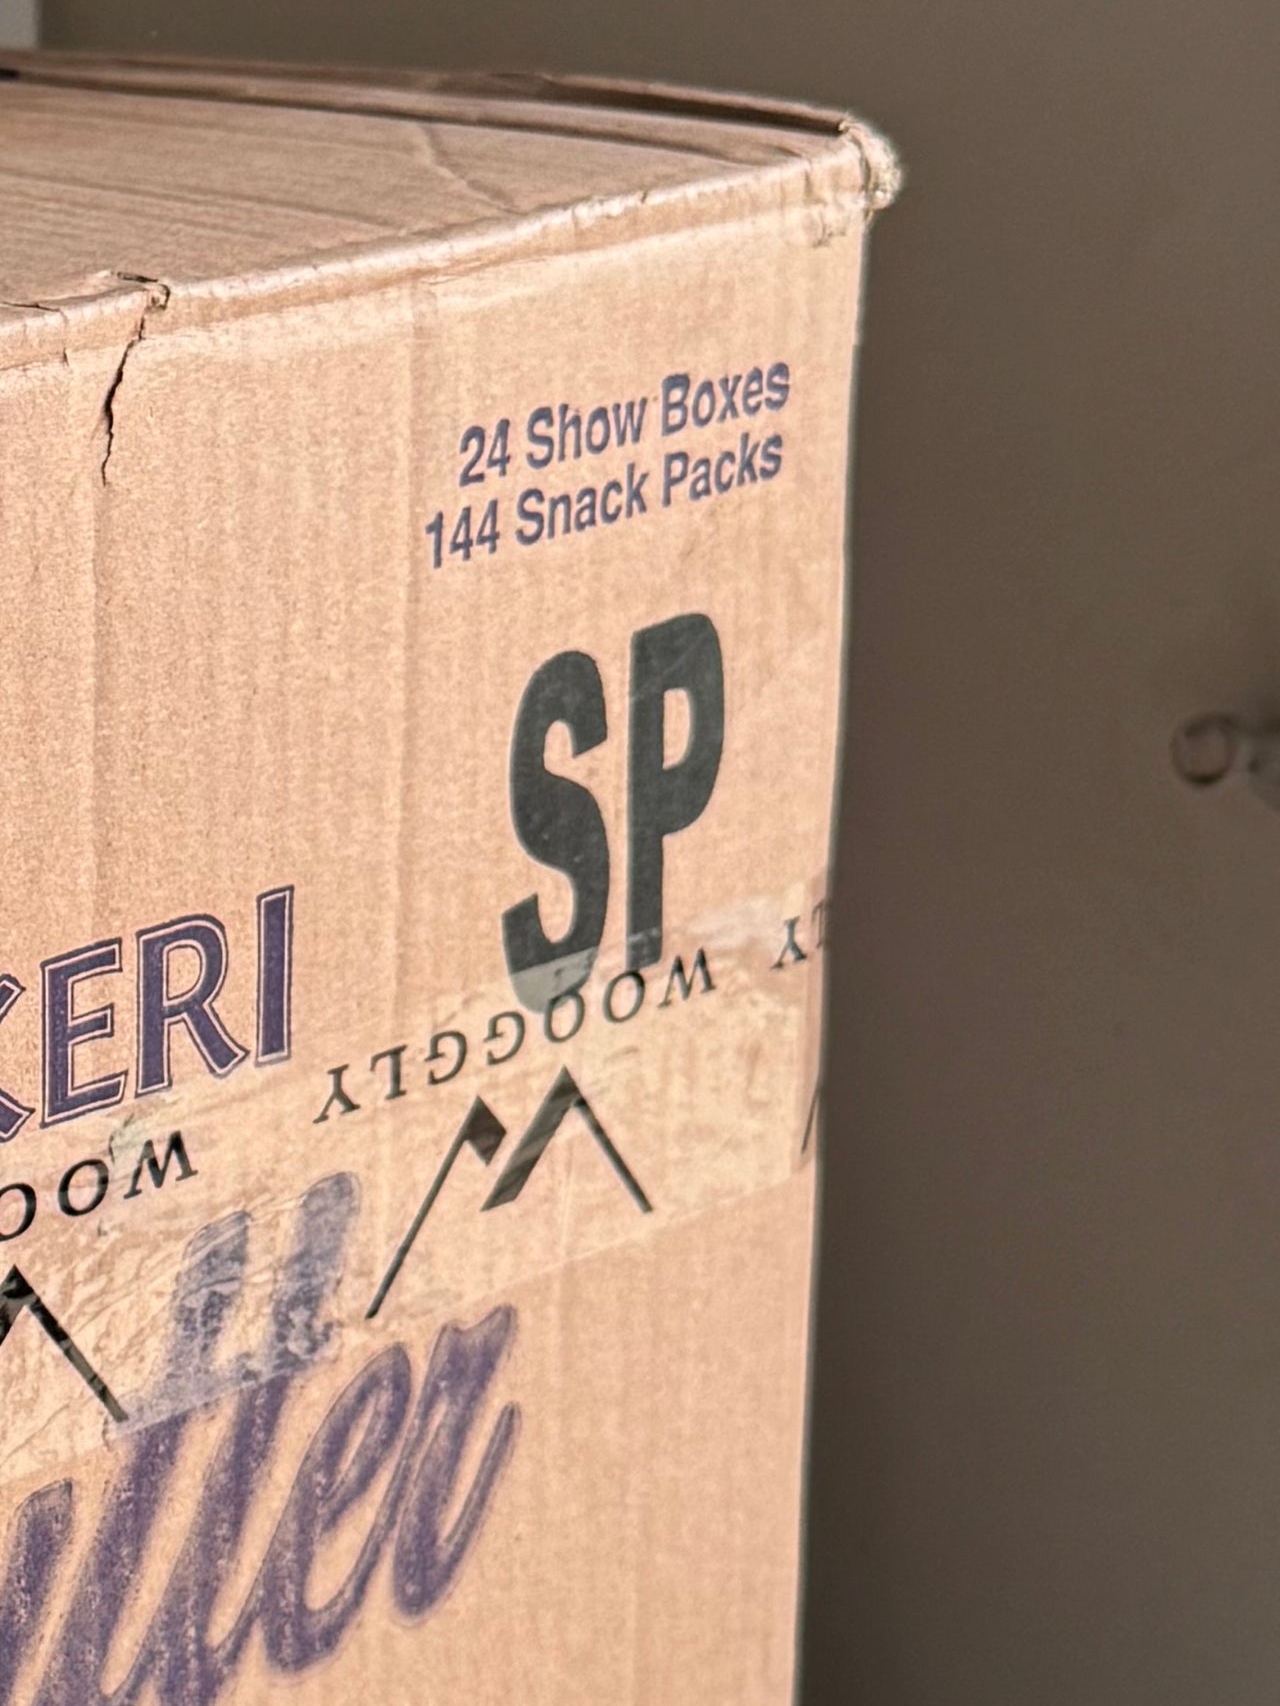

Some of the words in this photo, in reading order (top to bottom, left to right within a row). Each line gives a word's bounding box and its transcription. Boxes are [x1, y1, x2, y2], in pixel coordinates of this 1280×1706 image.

[423, 498, 501, 570] 144
[514, 464, 649, 546] Snack
[660, 428, 783, 508] Packs
[459, 418, 511, 486] 24
[525, 393, 648, 471] Show
[658, 359, 791, 439] Boxes
[501, 611, 725, 1015] SP
[311, 948, 718, 1124] WOOGGLY
